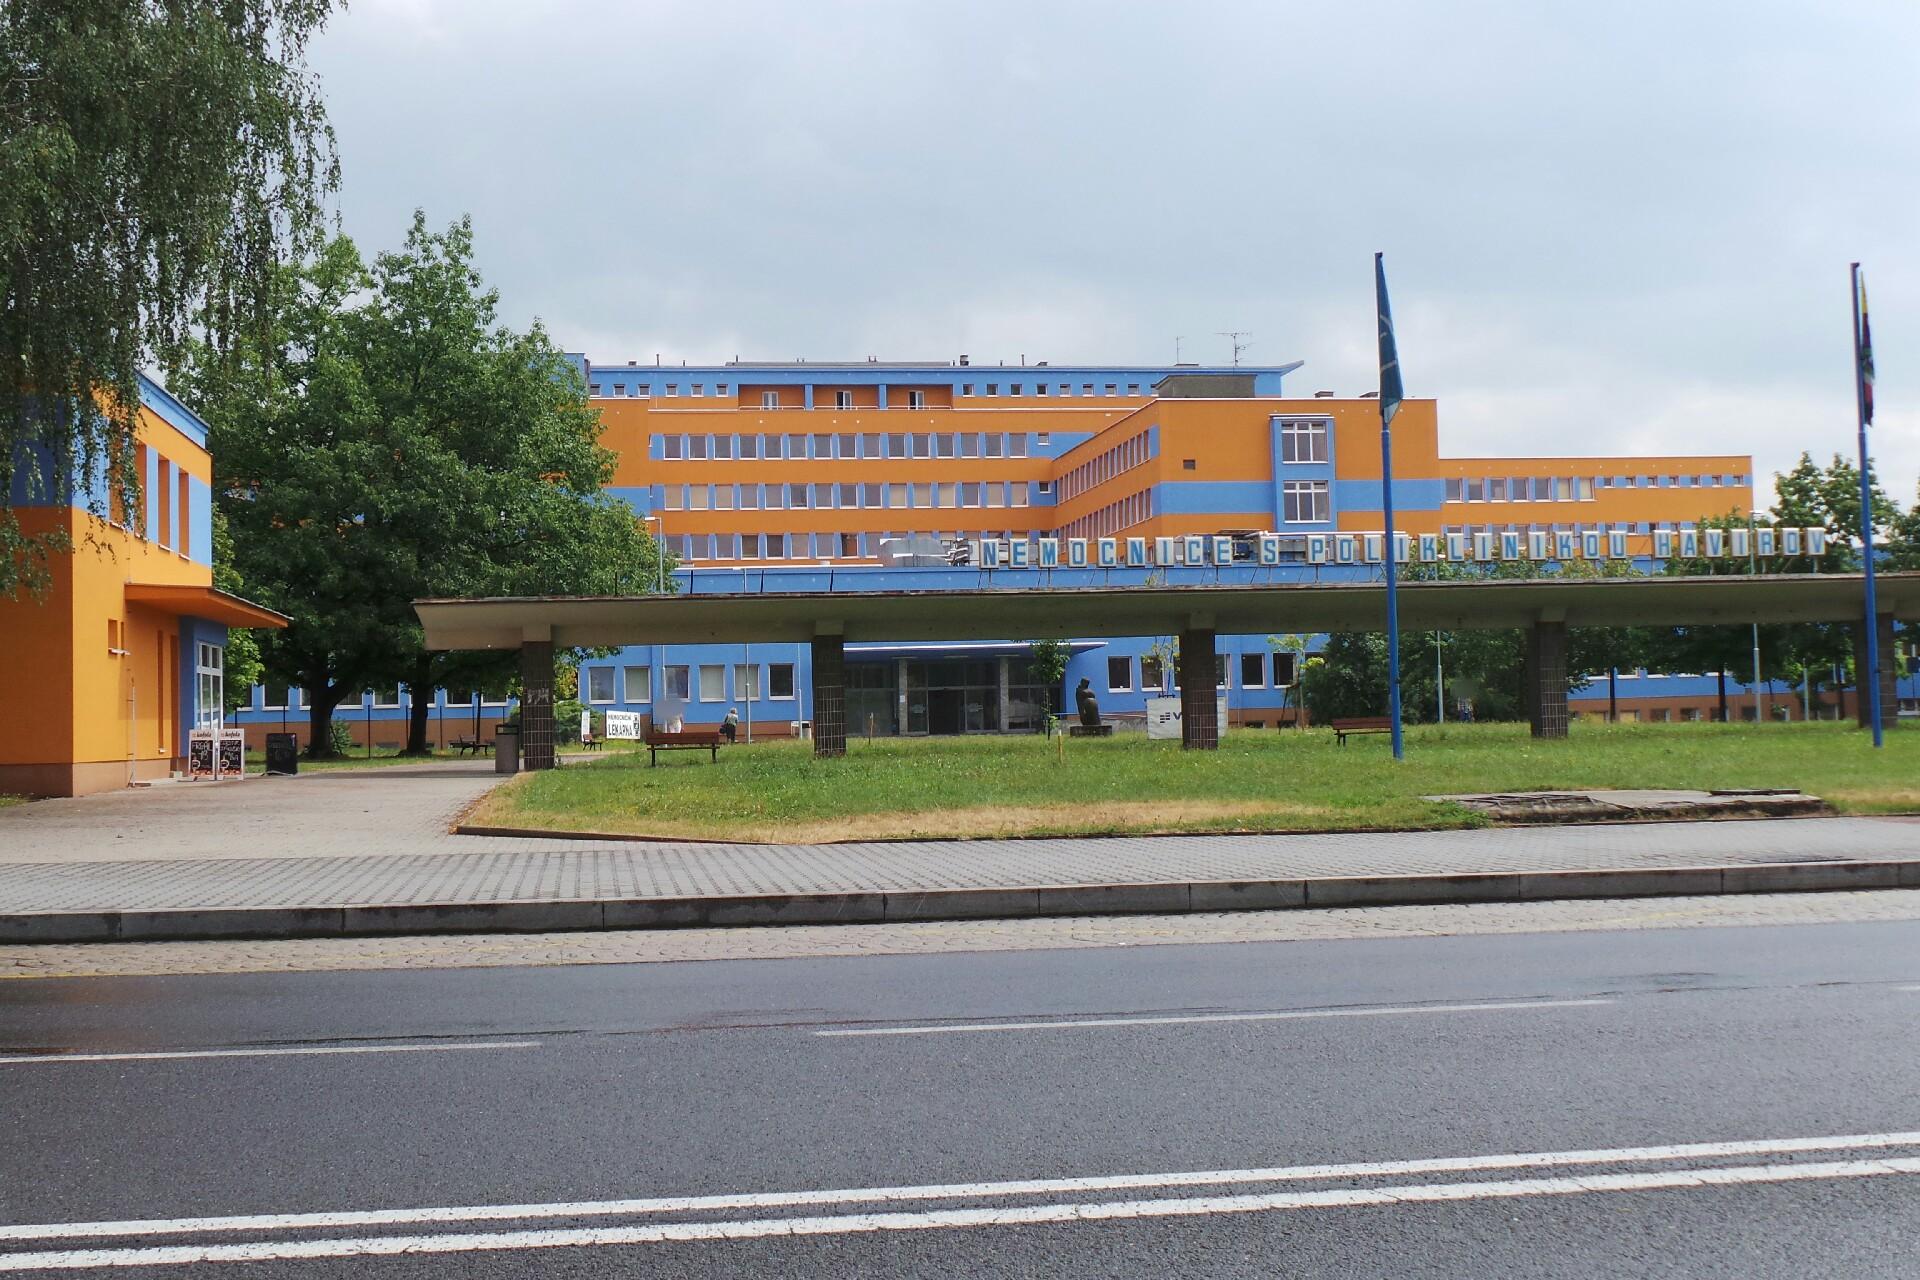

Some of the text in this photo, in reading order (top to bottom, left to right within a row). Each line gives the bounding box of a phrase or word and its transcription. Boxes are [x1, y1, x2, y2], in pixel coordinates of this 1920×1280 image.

[983, 540, 1230, 566] NEMOCNICE
[1264, 539, 1276, 563] S
[1312, 534, 1625, 562] POLIKLINIKOU
